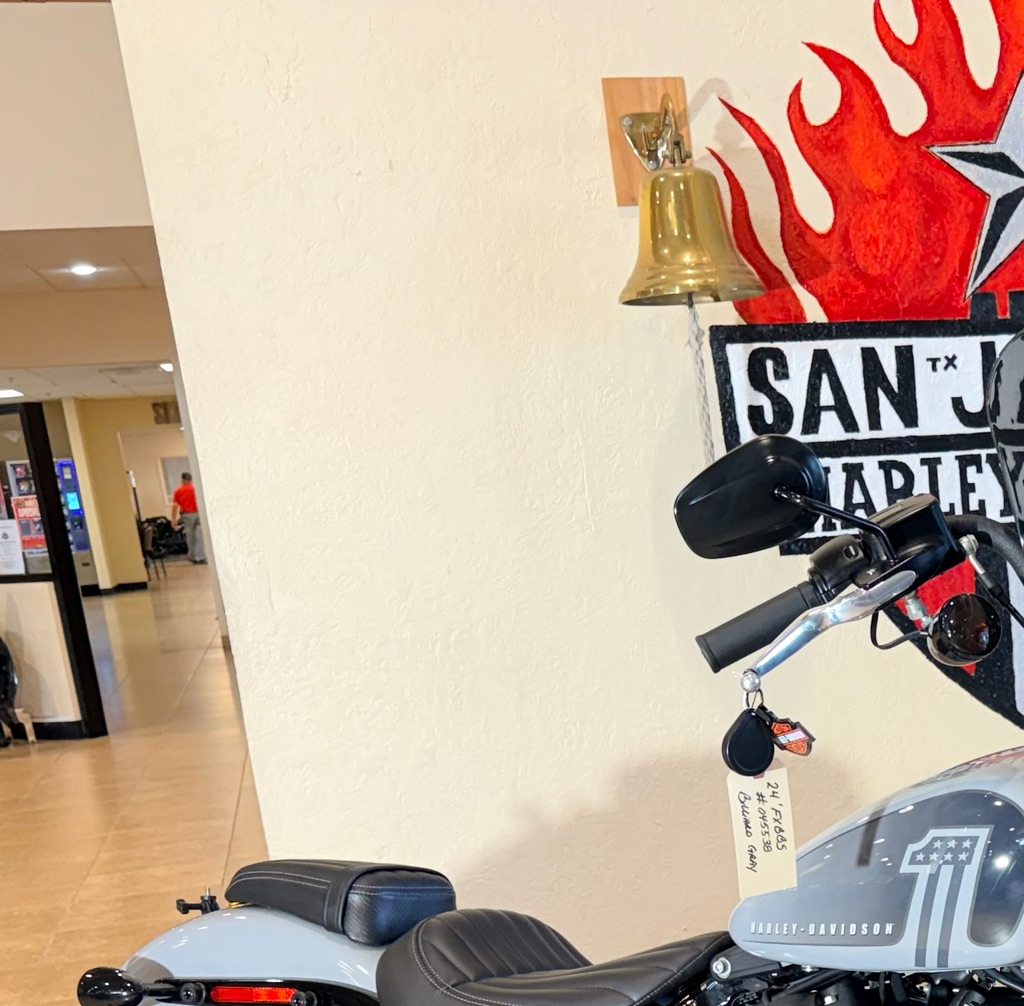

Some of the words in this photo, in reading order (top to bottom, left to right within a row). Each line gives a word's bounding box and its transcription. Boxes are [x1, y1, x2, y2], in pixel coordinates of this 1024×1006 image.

[747, 344, 919, 436] SAN
[926, 354, 958, 373] TX
[750, 922, 894, 936] HARLEY-DAVIDSON
